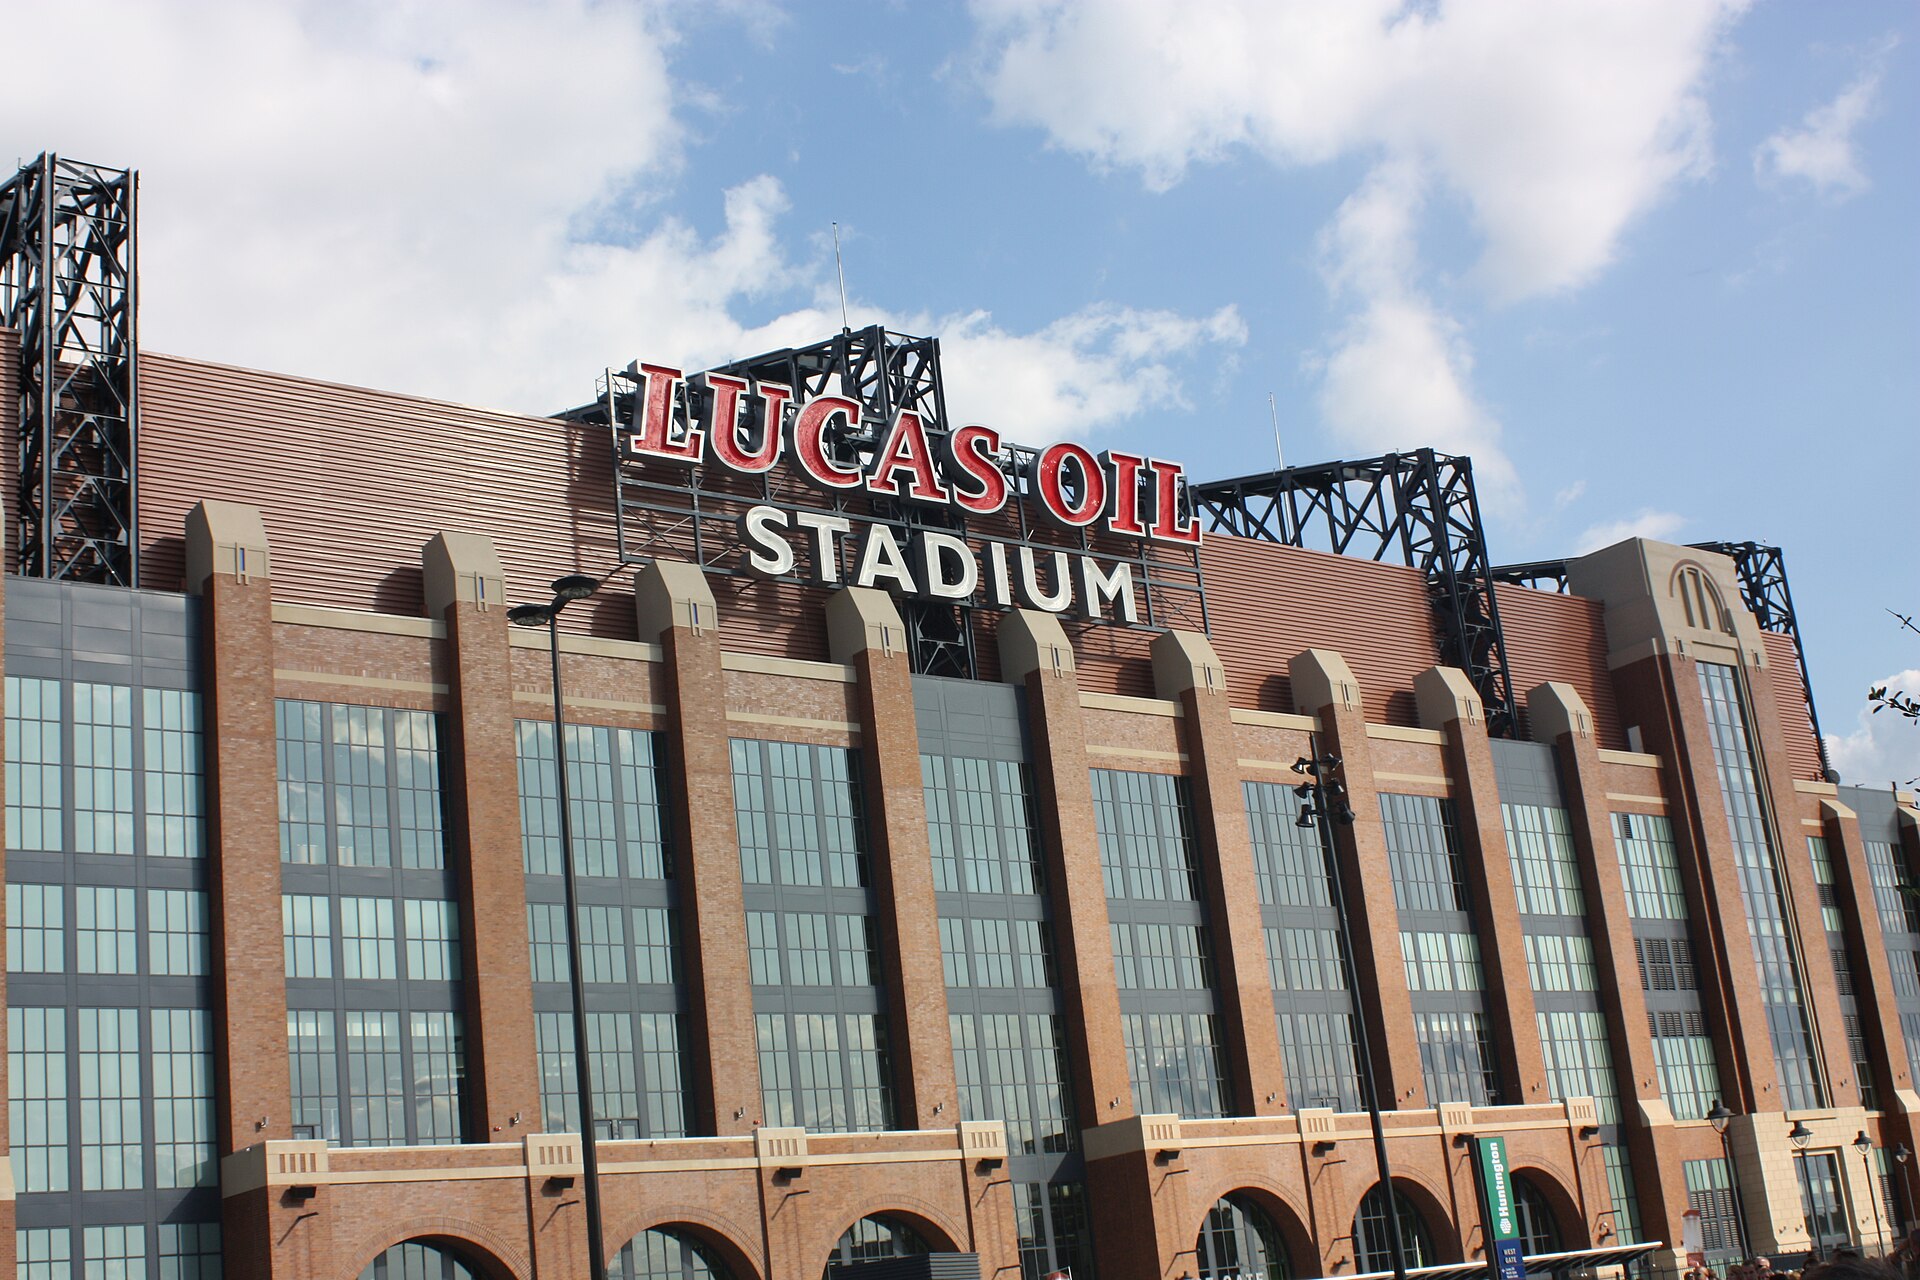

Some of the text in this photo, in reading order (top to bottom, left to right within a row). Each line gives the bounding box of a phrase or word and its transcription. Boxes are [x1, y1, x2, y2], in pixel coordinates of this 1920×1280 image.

[630, 359, 1203, 546] LUCAS OIL
[745, 505, 1138, 622] STADIUM
[1489, 1142, 1510, 1217] Huntington
